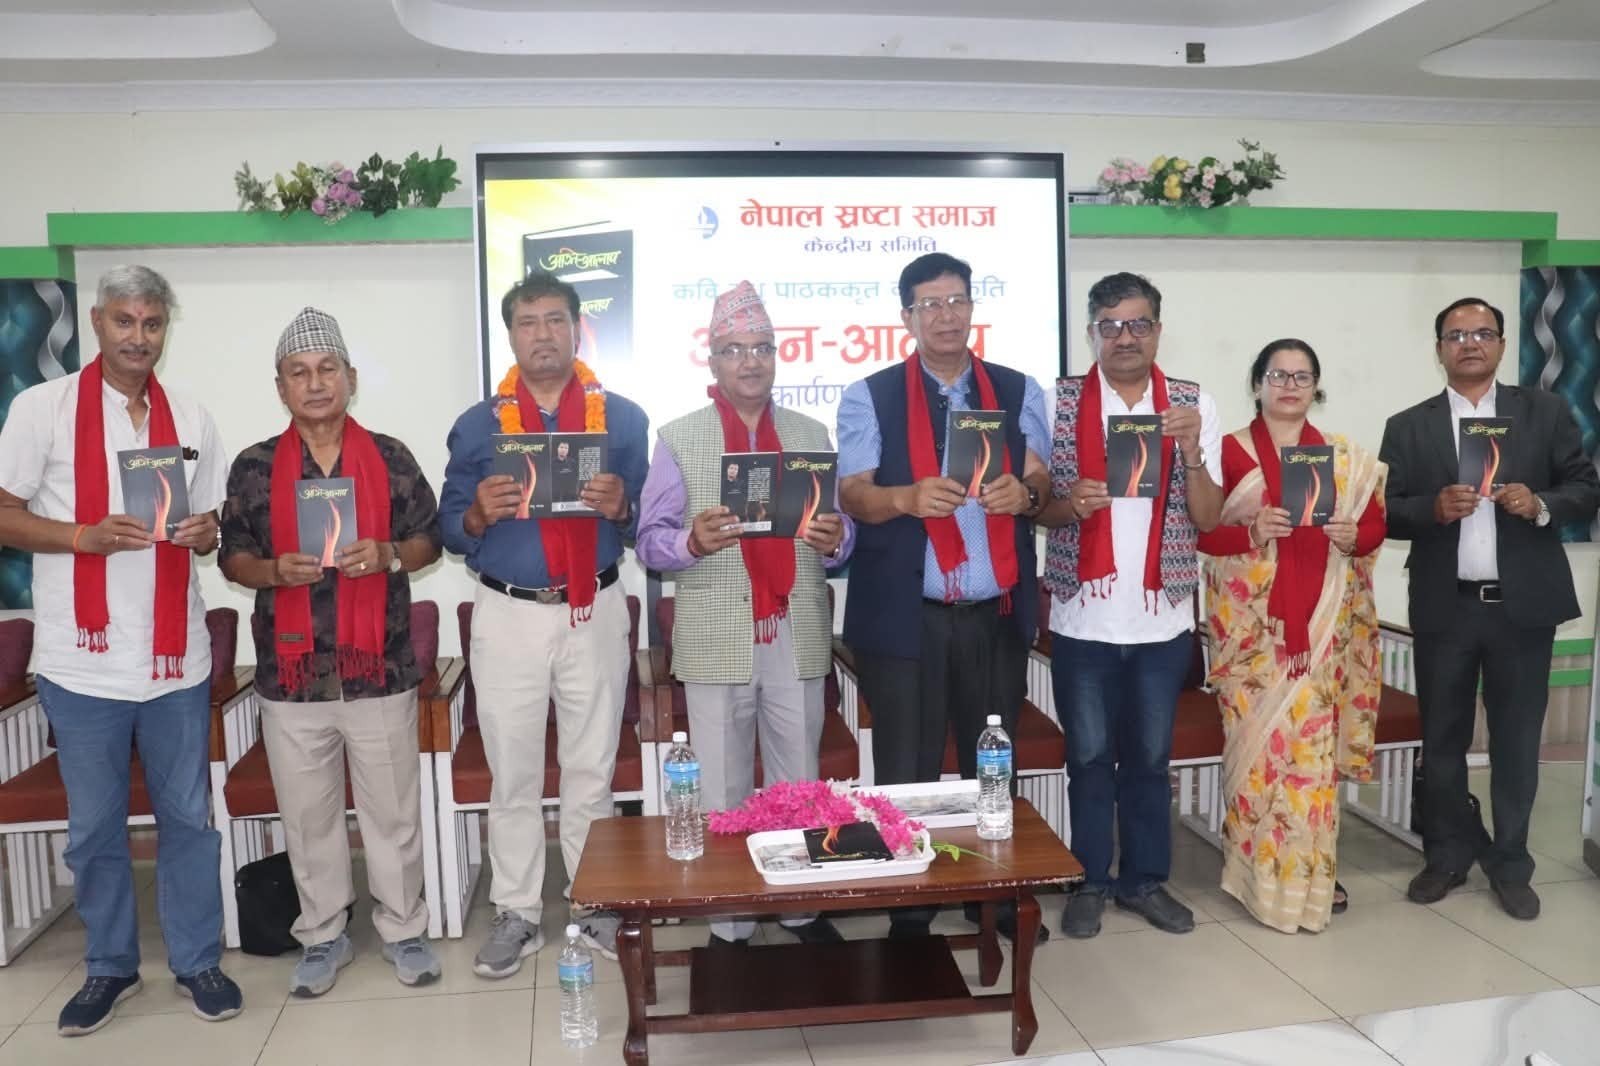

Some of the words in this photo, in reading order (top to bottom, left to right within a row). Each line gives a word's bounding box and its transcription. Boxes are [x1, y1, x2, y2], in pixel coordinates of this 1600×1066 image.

[739, 198, 824, 228] नेपाल
[834, 205, 903, 230] स्रष्टा
[912, 205, 998, 229] समाज
[803, 236, 872, 254] केन्द्रीय
[880, 235, 938, 253] समिति
[672, 277, 719, 302] कवि
[774, 281, 880, 305] पाठककृत
